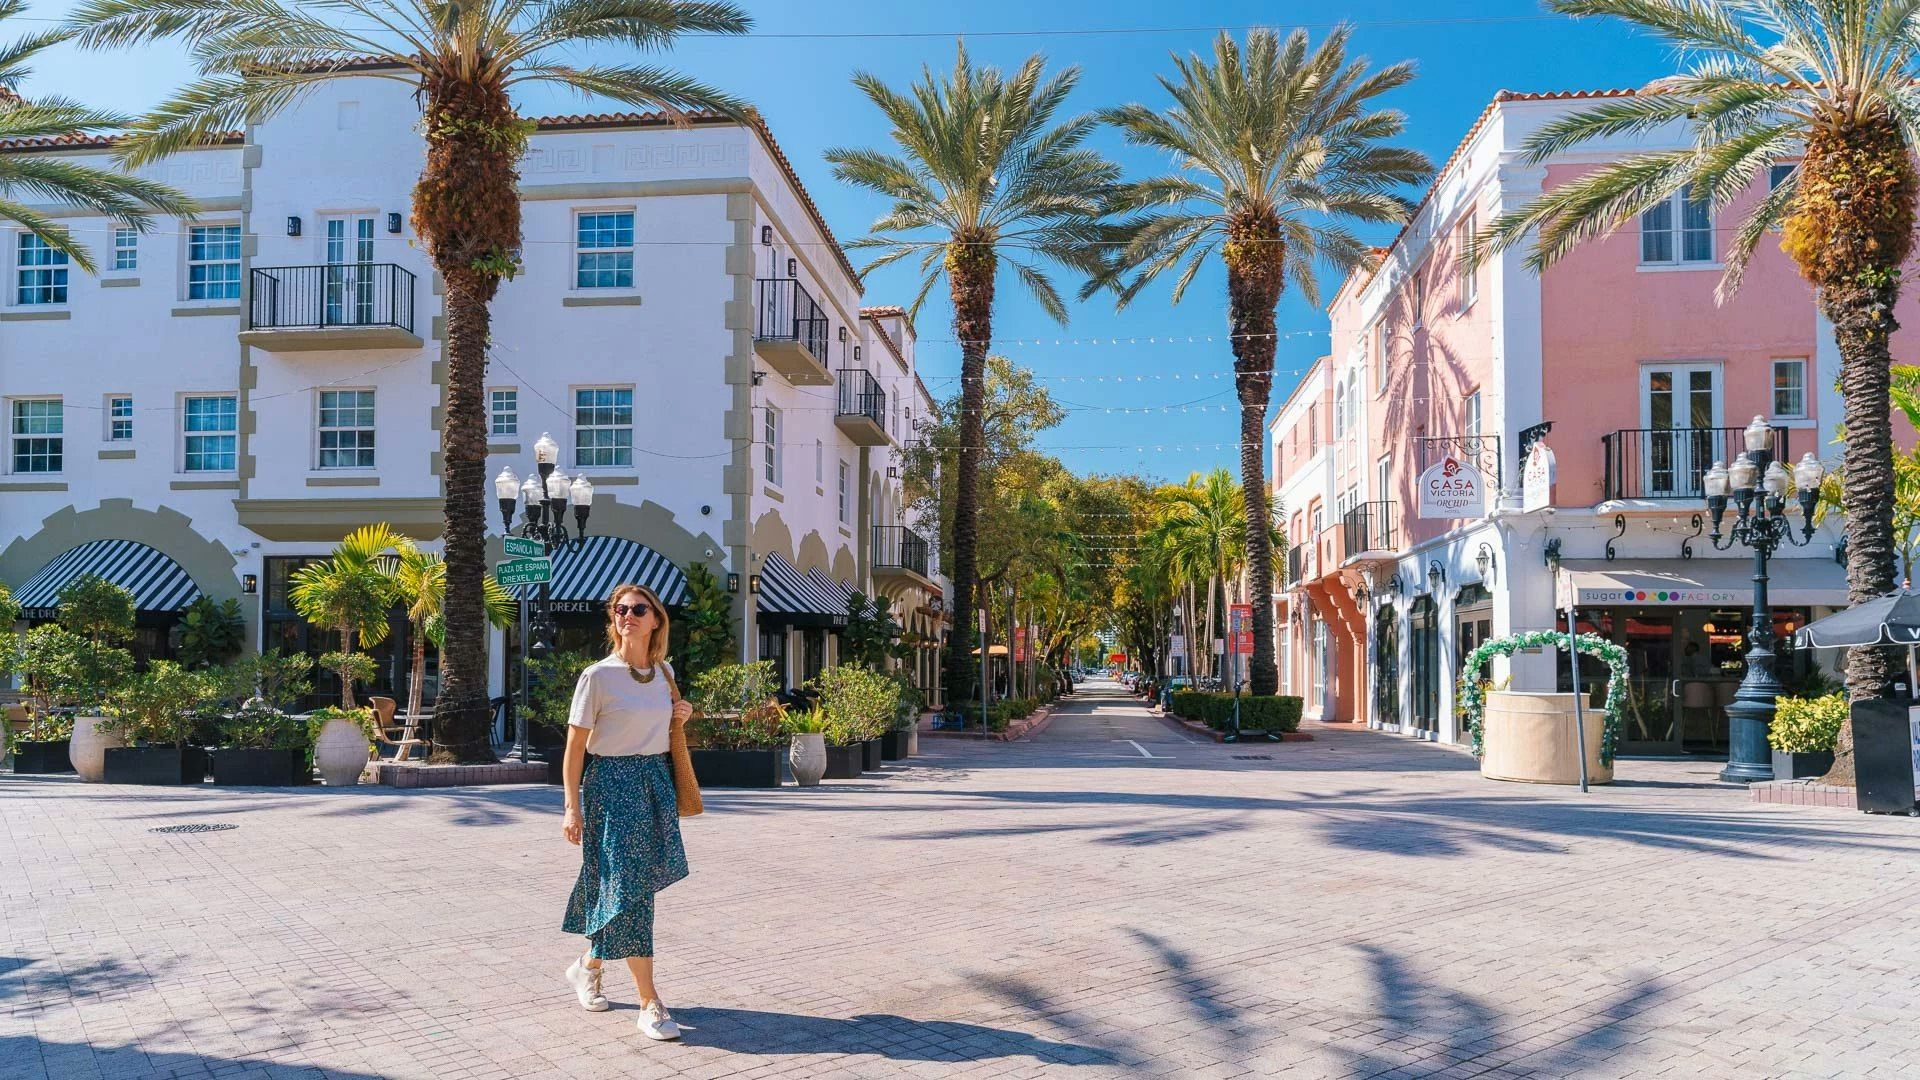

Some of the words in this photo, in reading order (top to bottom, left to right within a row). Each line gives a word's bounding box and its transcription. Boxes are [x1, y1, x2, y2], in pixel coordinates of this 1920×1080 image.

[1430, 479, 1475, 490] CASA
[1436, 500, 1469, 509] ORCHID
[506, 541, 533, 555] ESPAÑOLA
[498, 566, 514, 575] PLAZA
[515, 564, 523, 572] DE
[525, 561, 549, 571] ESPAÑA
[502, 574, 531, 584] DREXEL
[533, 572, 544, 581] AV
[1586, 592, 1622, 601] sugar
[1681, 592, 1736, 601] FACTORY
[549, 602, 592, 612] DREXEL
